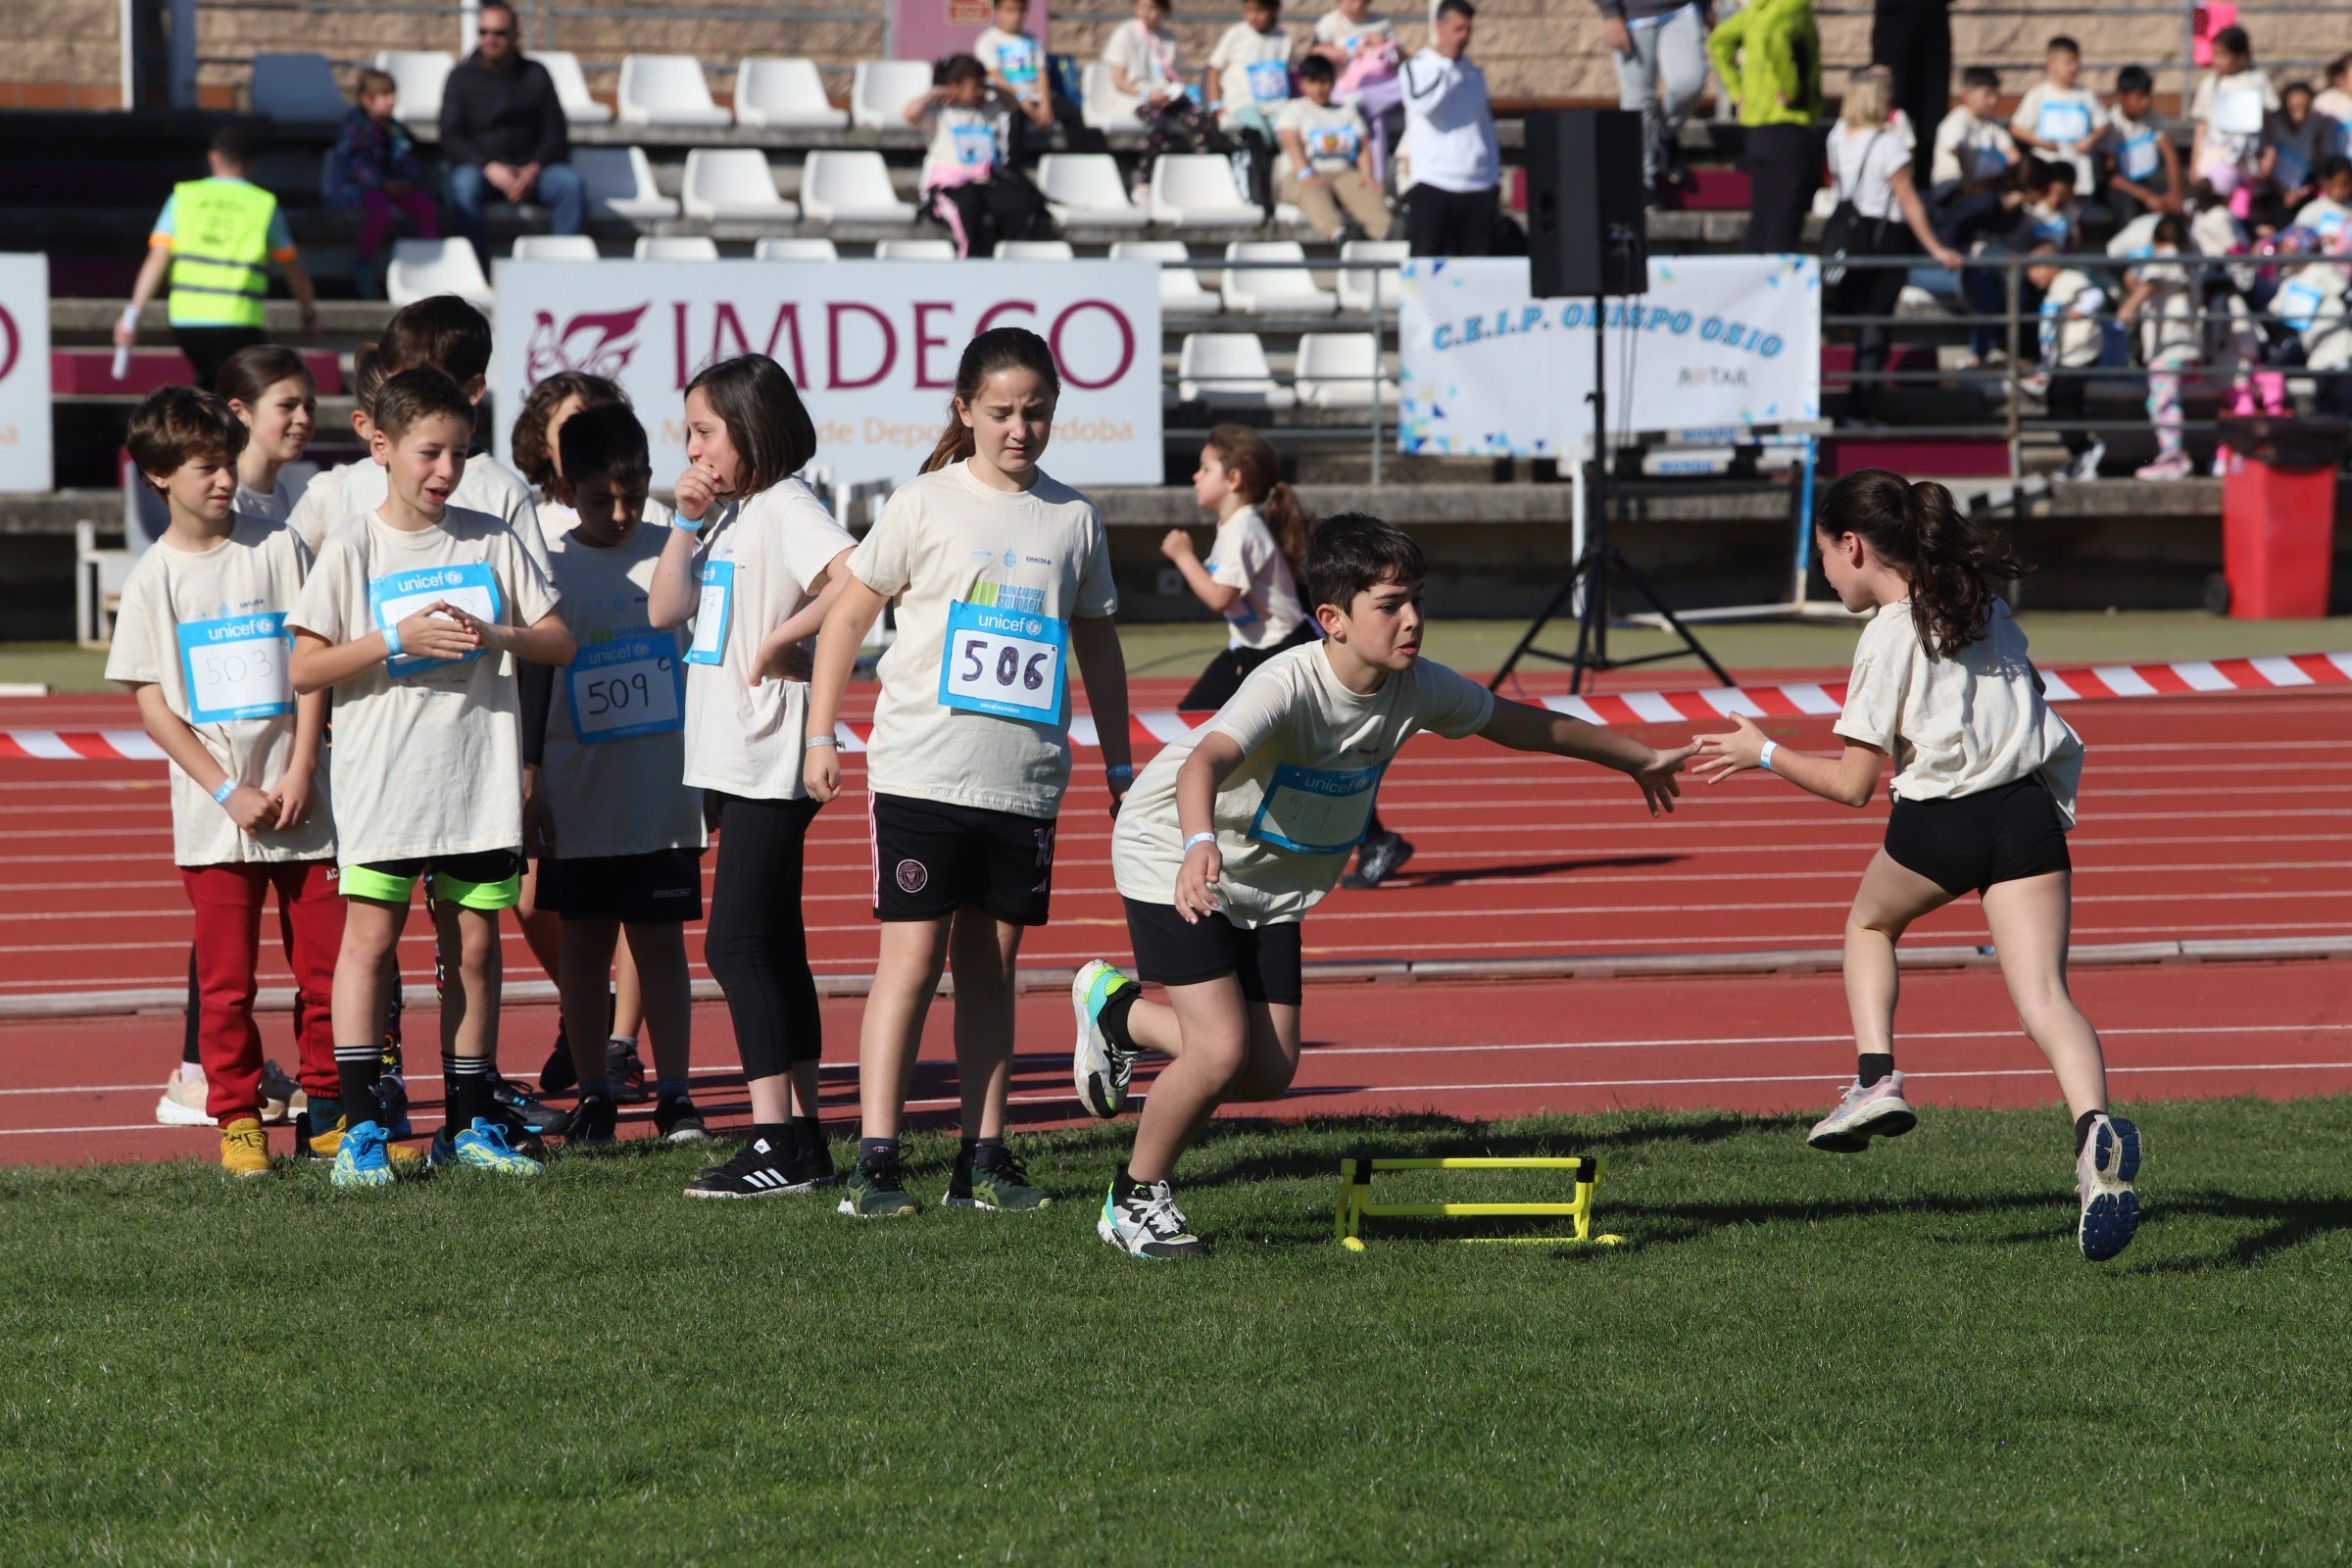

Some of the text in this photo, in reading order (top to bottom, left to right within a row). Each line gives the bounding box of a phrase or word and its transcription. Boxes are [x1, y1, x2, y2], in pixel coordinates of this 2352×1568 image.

[1699, 315, 1784, 359] OSIO
[398, 571, 444, 593] unicef
[208, 619, 255, 640] unicef
[979, 614, 1025, 633] unicef
[588, 643, 631, 664] unicef
[206, 650, 273, 685] 503
[961, 640, 1048, 690] 506
[588, 673, 649, 714] 509
[1304, 776, 1354, 794] unicef
